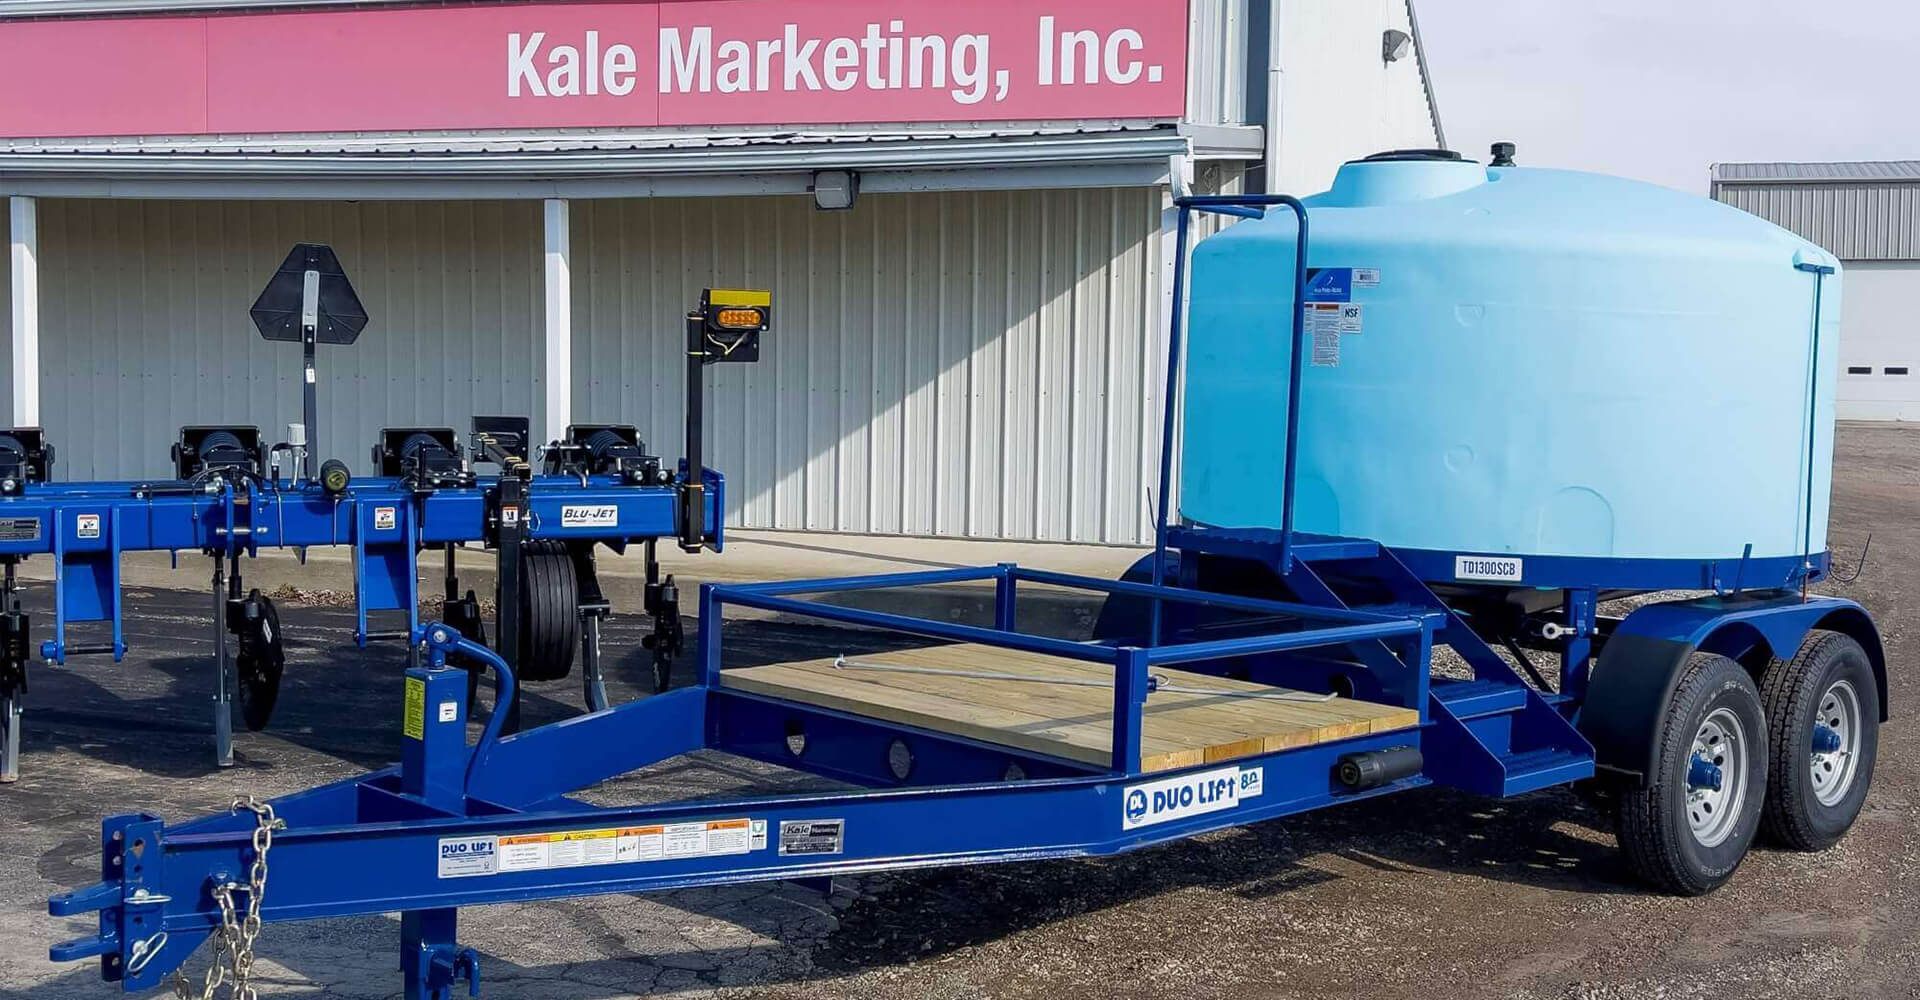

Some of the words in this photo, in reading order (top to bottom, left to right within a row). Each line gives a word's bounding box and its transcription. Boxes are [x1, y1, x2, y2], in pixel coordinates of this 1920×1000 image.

[506, 31, 637, 98] Kale
[659, 21, 1010, 104] Marketing,
[1038, 16, 1162, 86] Inc.
[1344, 308, 1358, 318] NSF
[1463, 560, 1516, 575] TD1300SCB
[1153, 785, 1194, 814] DUO
[1198, 776, 1236, 804] LIFT
[786, 824, 810, 834] Kale
[442, 843, 467, 854] DUO
